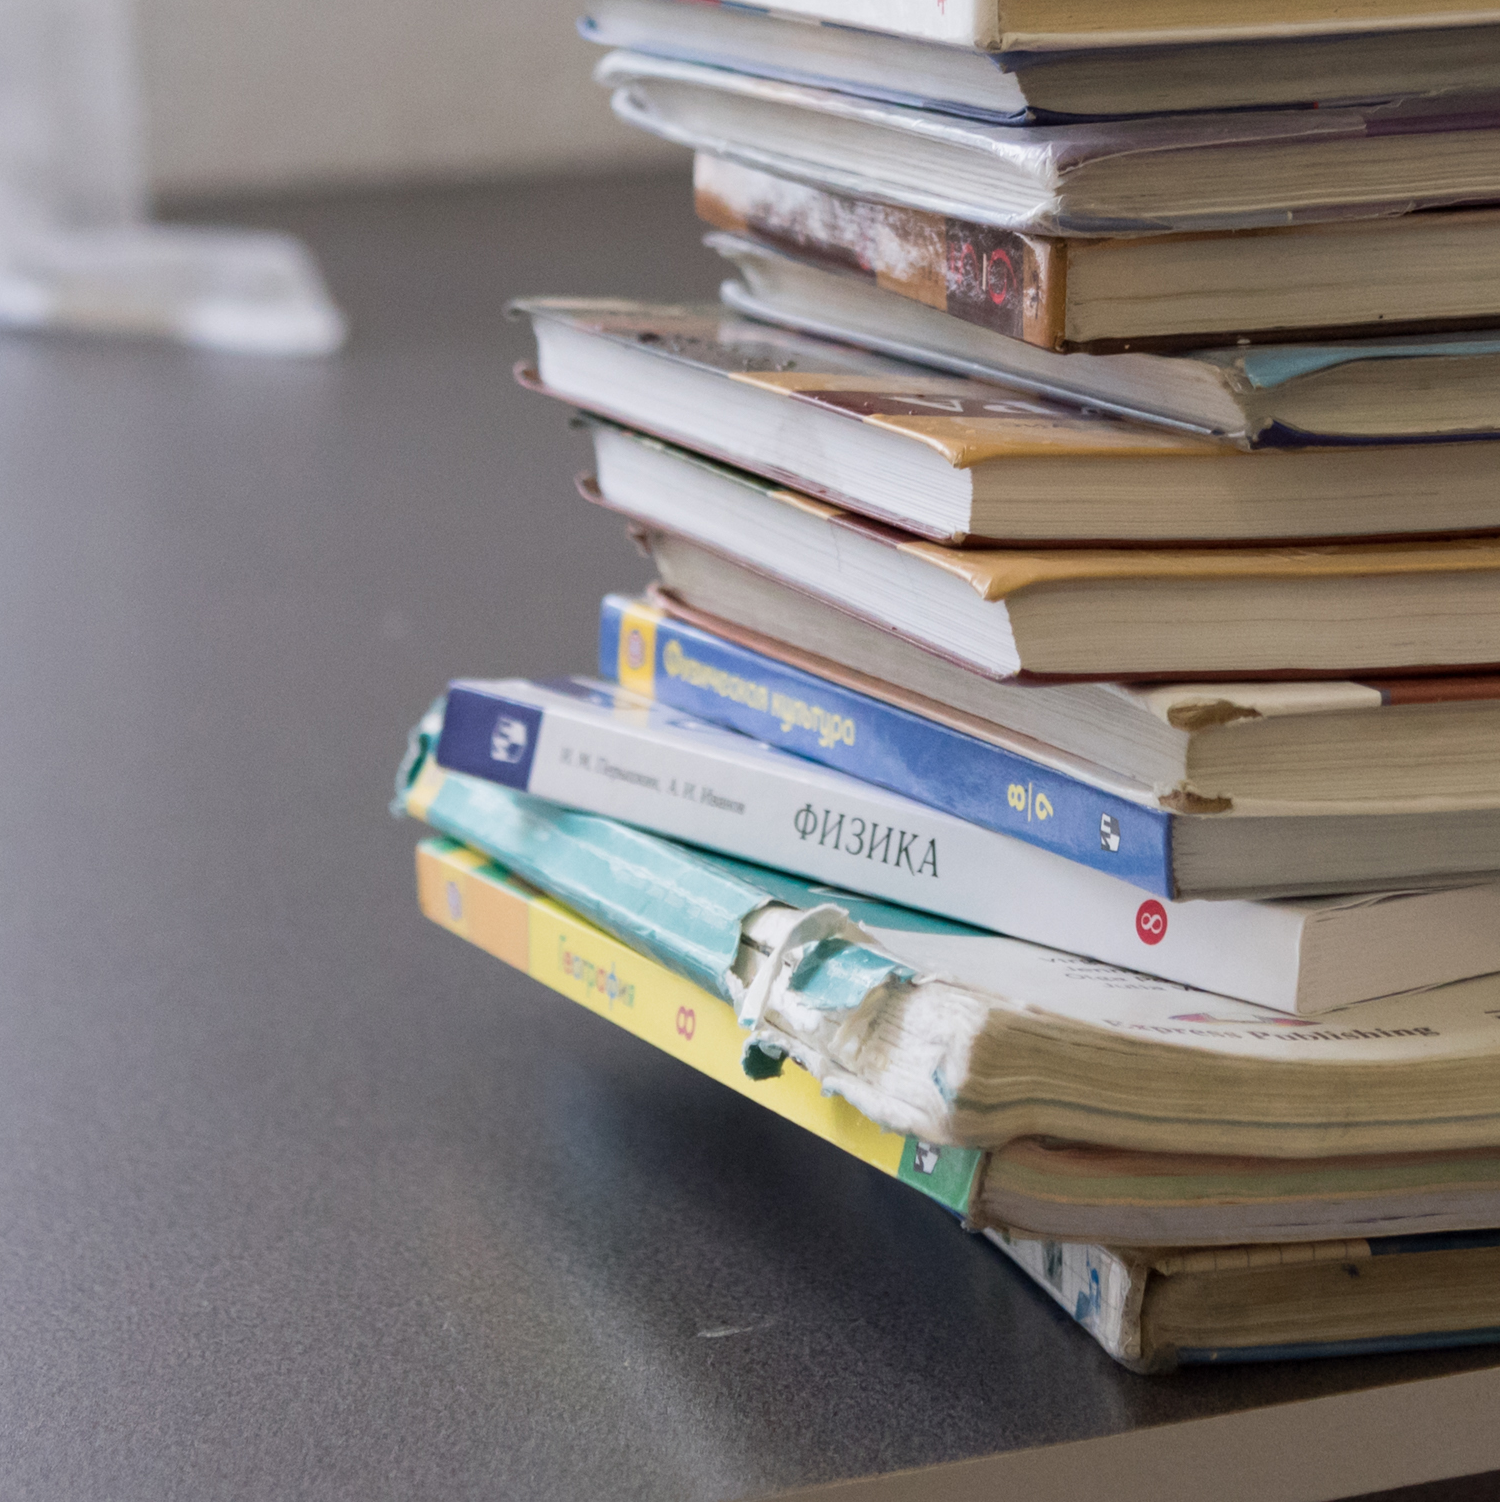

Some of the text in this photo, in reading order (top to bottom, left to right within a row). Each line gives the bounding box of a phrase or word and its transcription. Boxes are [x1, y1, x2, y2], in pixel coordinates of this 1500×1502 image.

[662, 638, 856, 750] Физическая культура
[793, 802, 941, 880] ФИЗИКА
[557, 934, 636, 1011] География
[1101, 1019, 1441, 1042] Express Publishing
